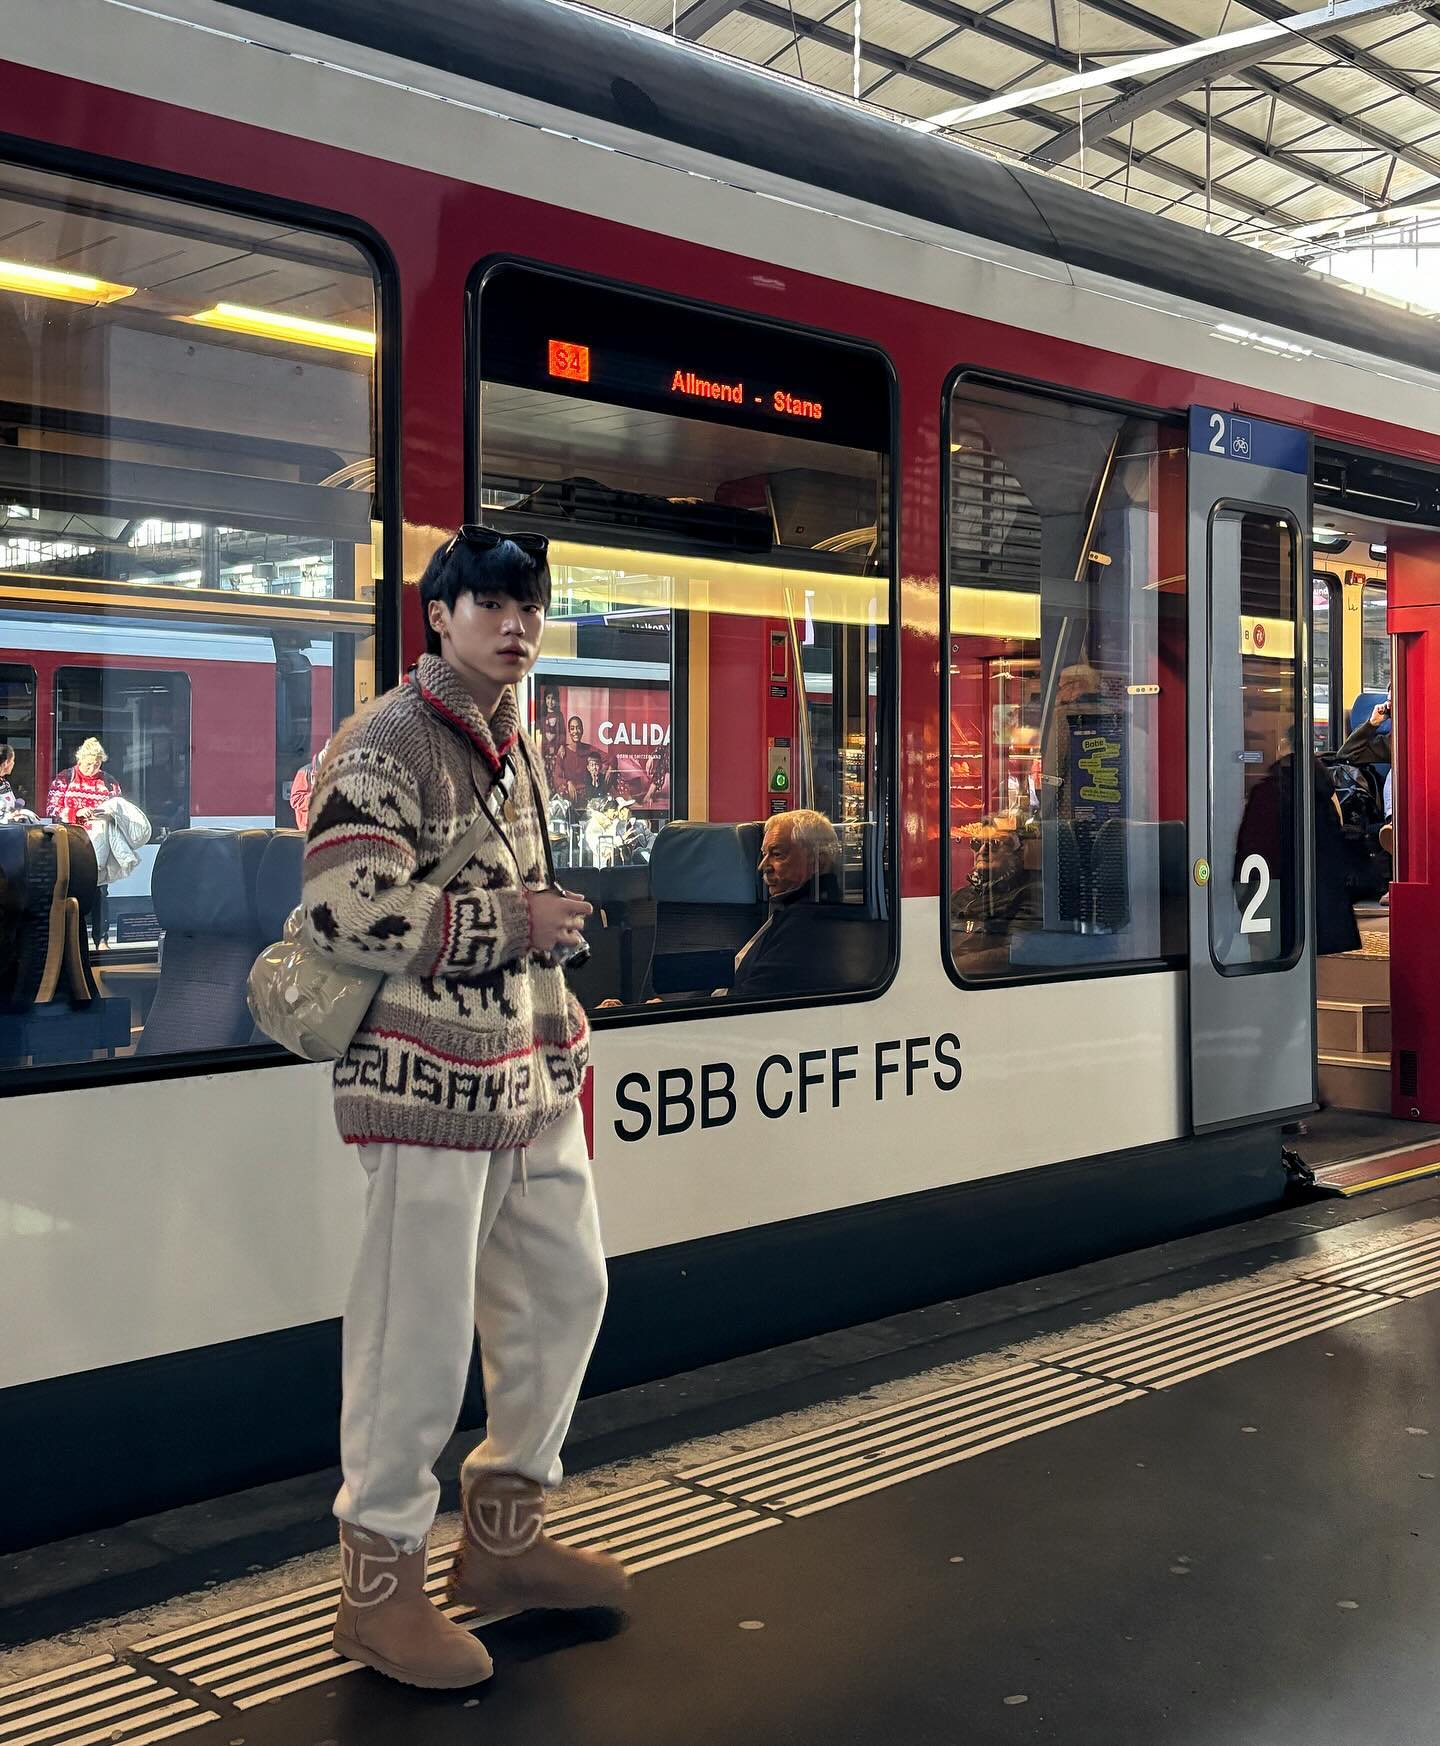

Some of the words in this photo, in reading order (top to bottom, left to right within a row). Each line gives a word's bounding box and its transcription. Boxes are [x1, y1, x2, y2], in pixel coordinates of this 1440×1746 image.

[555, 350, 581, 373] S4
[671, 370, 743, 404] Allmend
[773, 391, 823, 420] Stans
[1209, 413, 1226, 455] 2
[1240, 853, 1271, 934] 2
[613, 1062, 737, 1142] SBB
[756, 1044, 859, 1119] CFF
[875, 1032, 962, 1101] FFS
